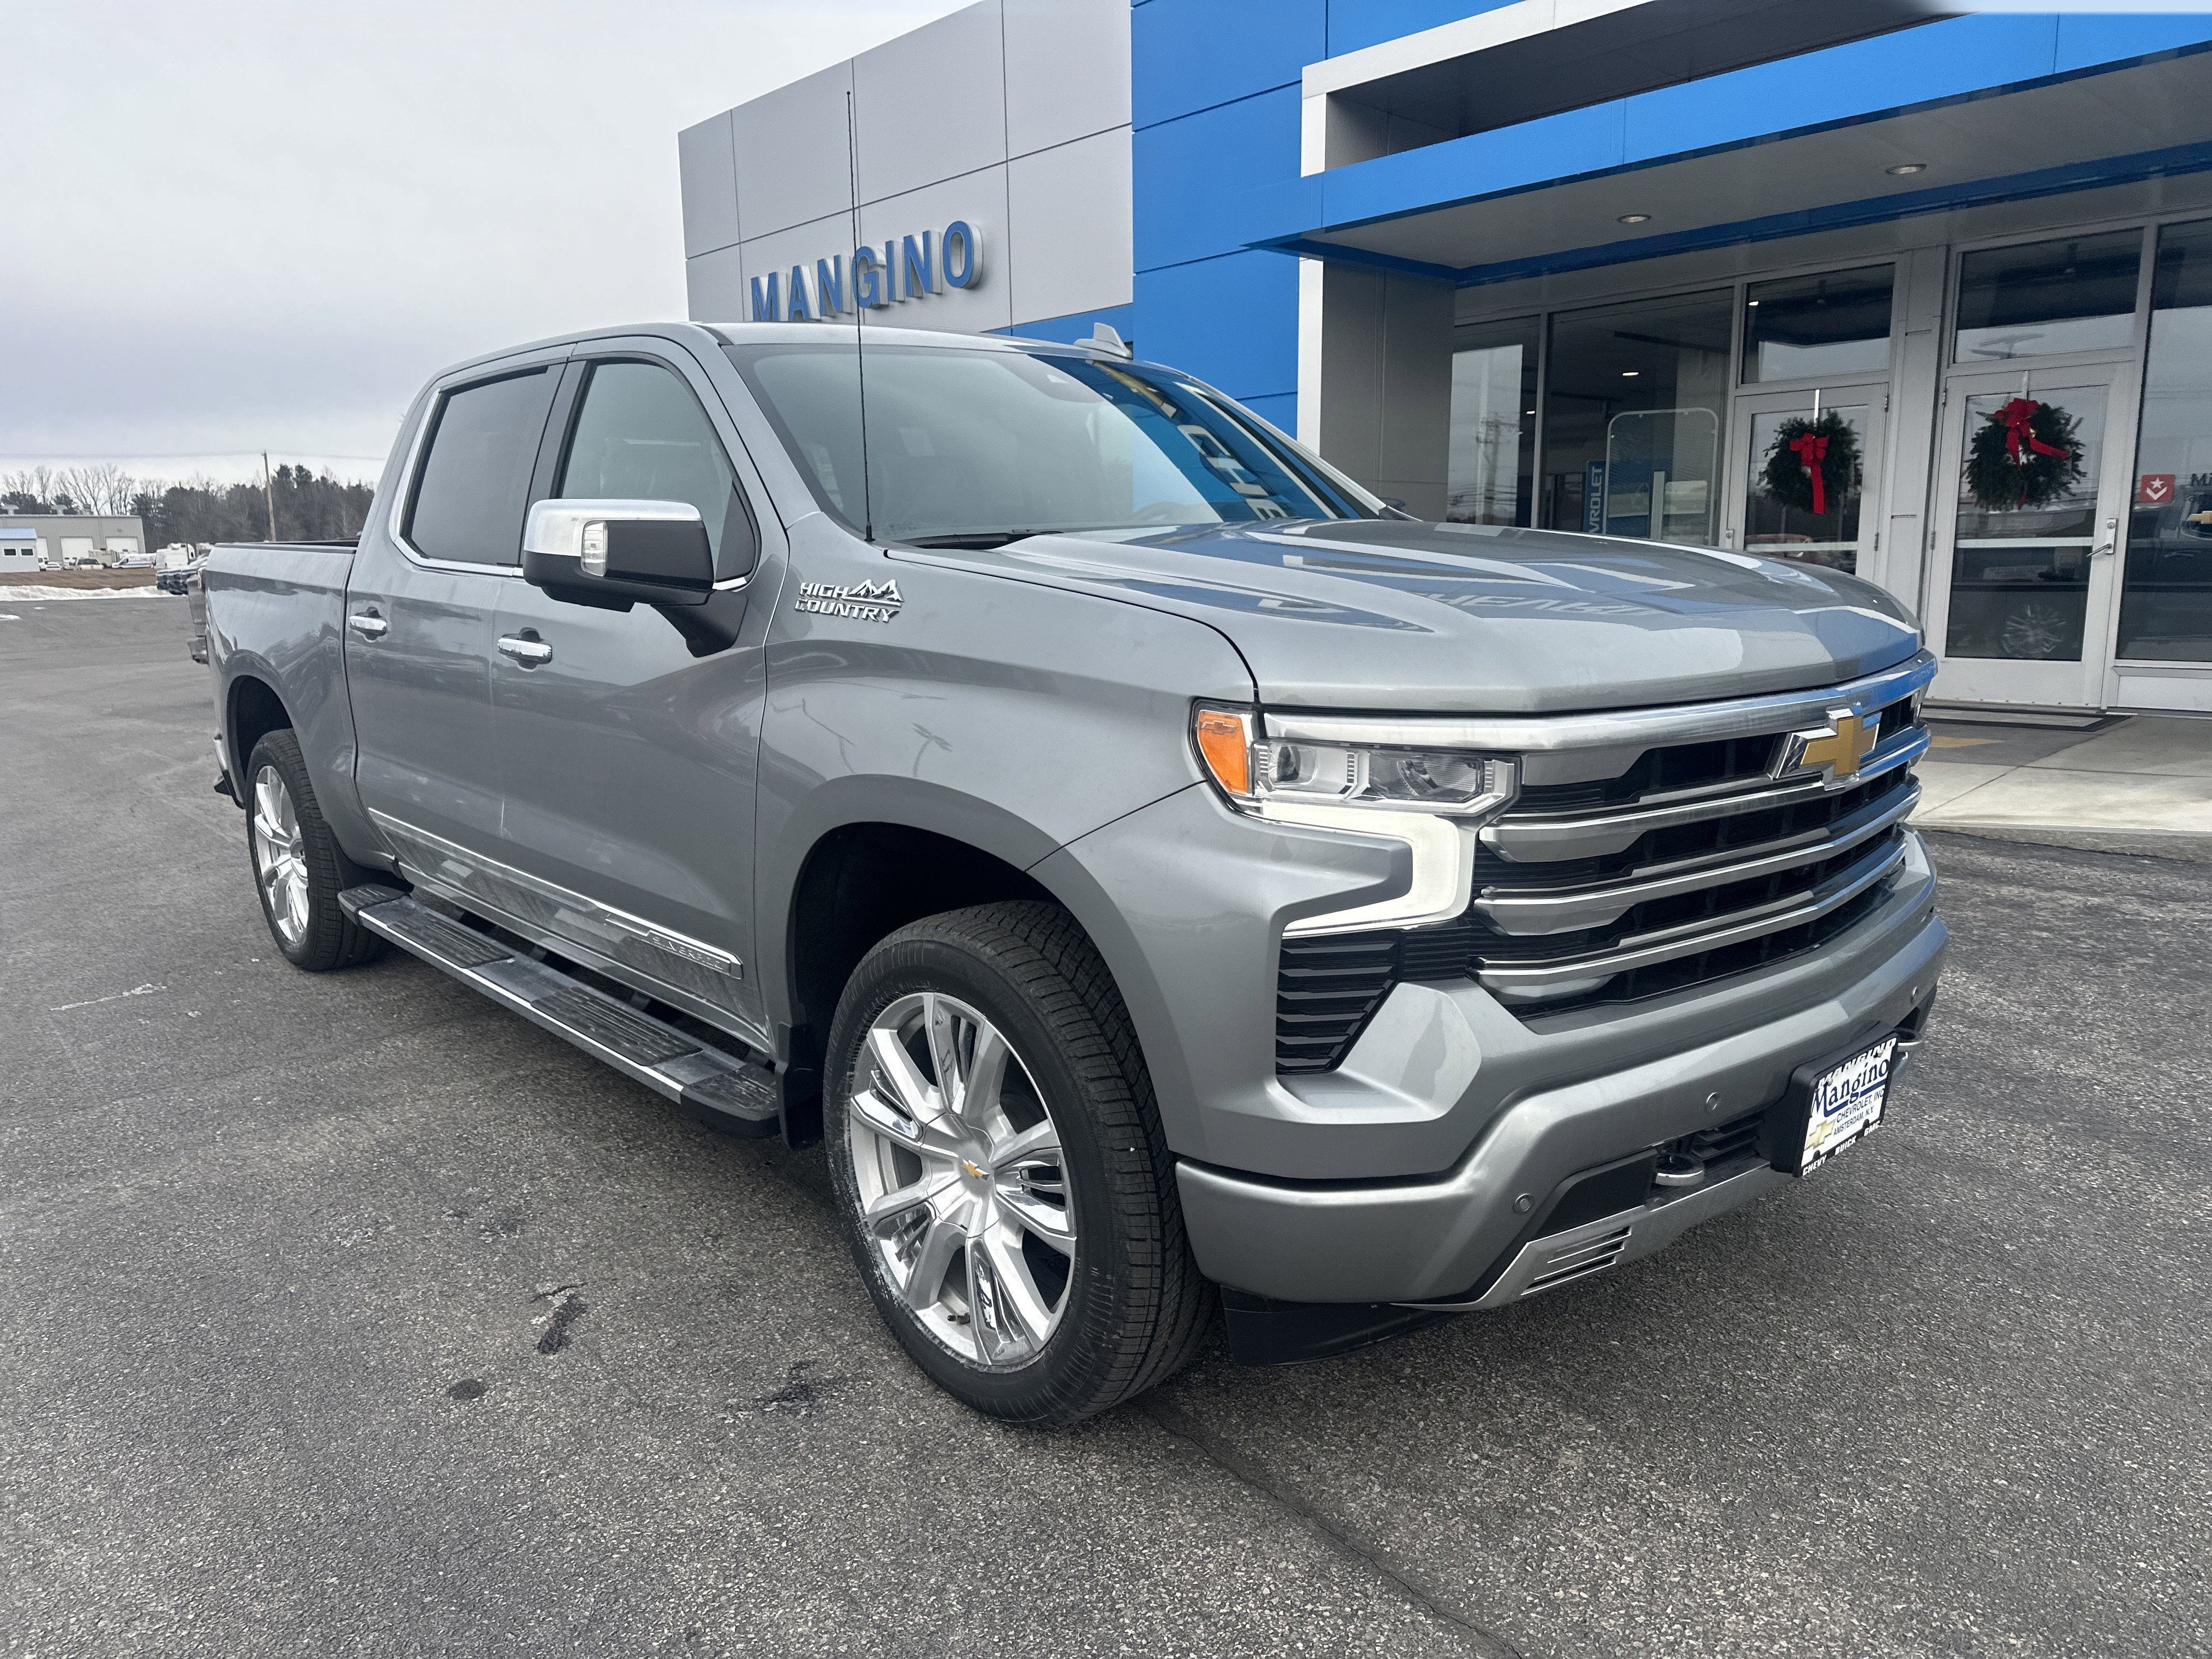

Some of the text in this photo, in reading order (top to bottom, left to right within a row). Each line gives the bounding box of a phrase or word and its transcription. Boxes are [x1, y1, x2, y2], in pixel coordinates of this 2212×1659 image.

[751, 221, 980, 321] MANGINO
[794, 598, 899, 623] COUNTRY
[799, 582, 849, 600] HIGH
[1814, 1059, 1890, 1117] Mangino
[1802, 1120, 1881, 1176] CHEVY BUICK GMC
